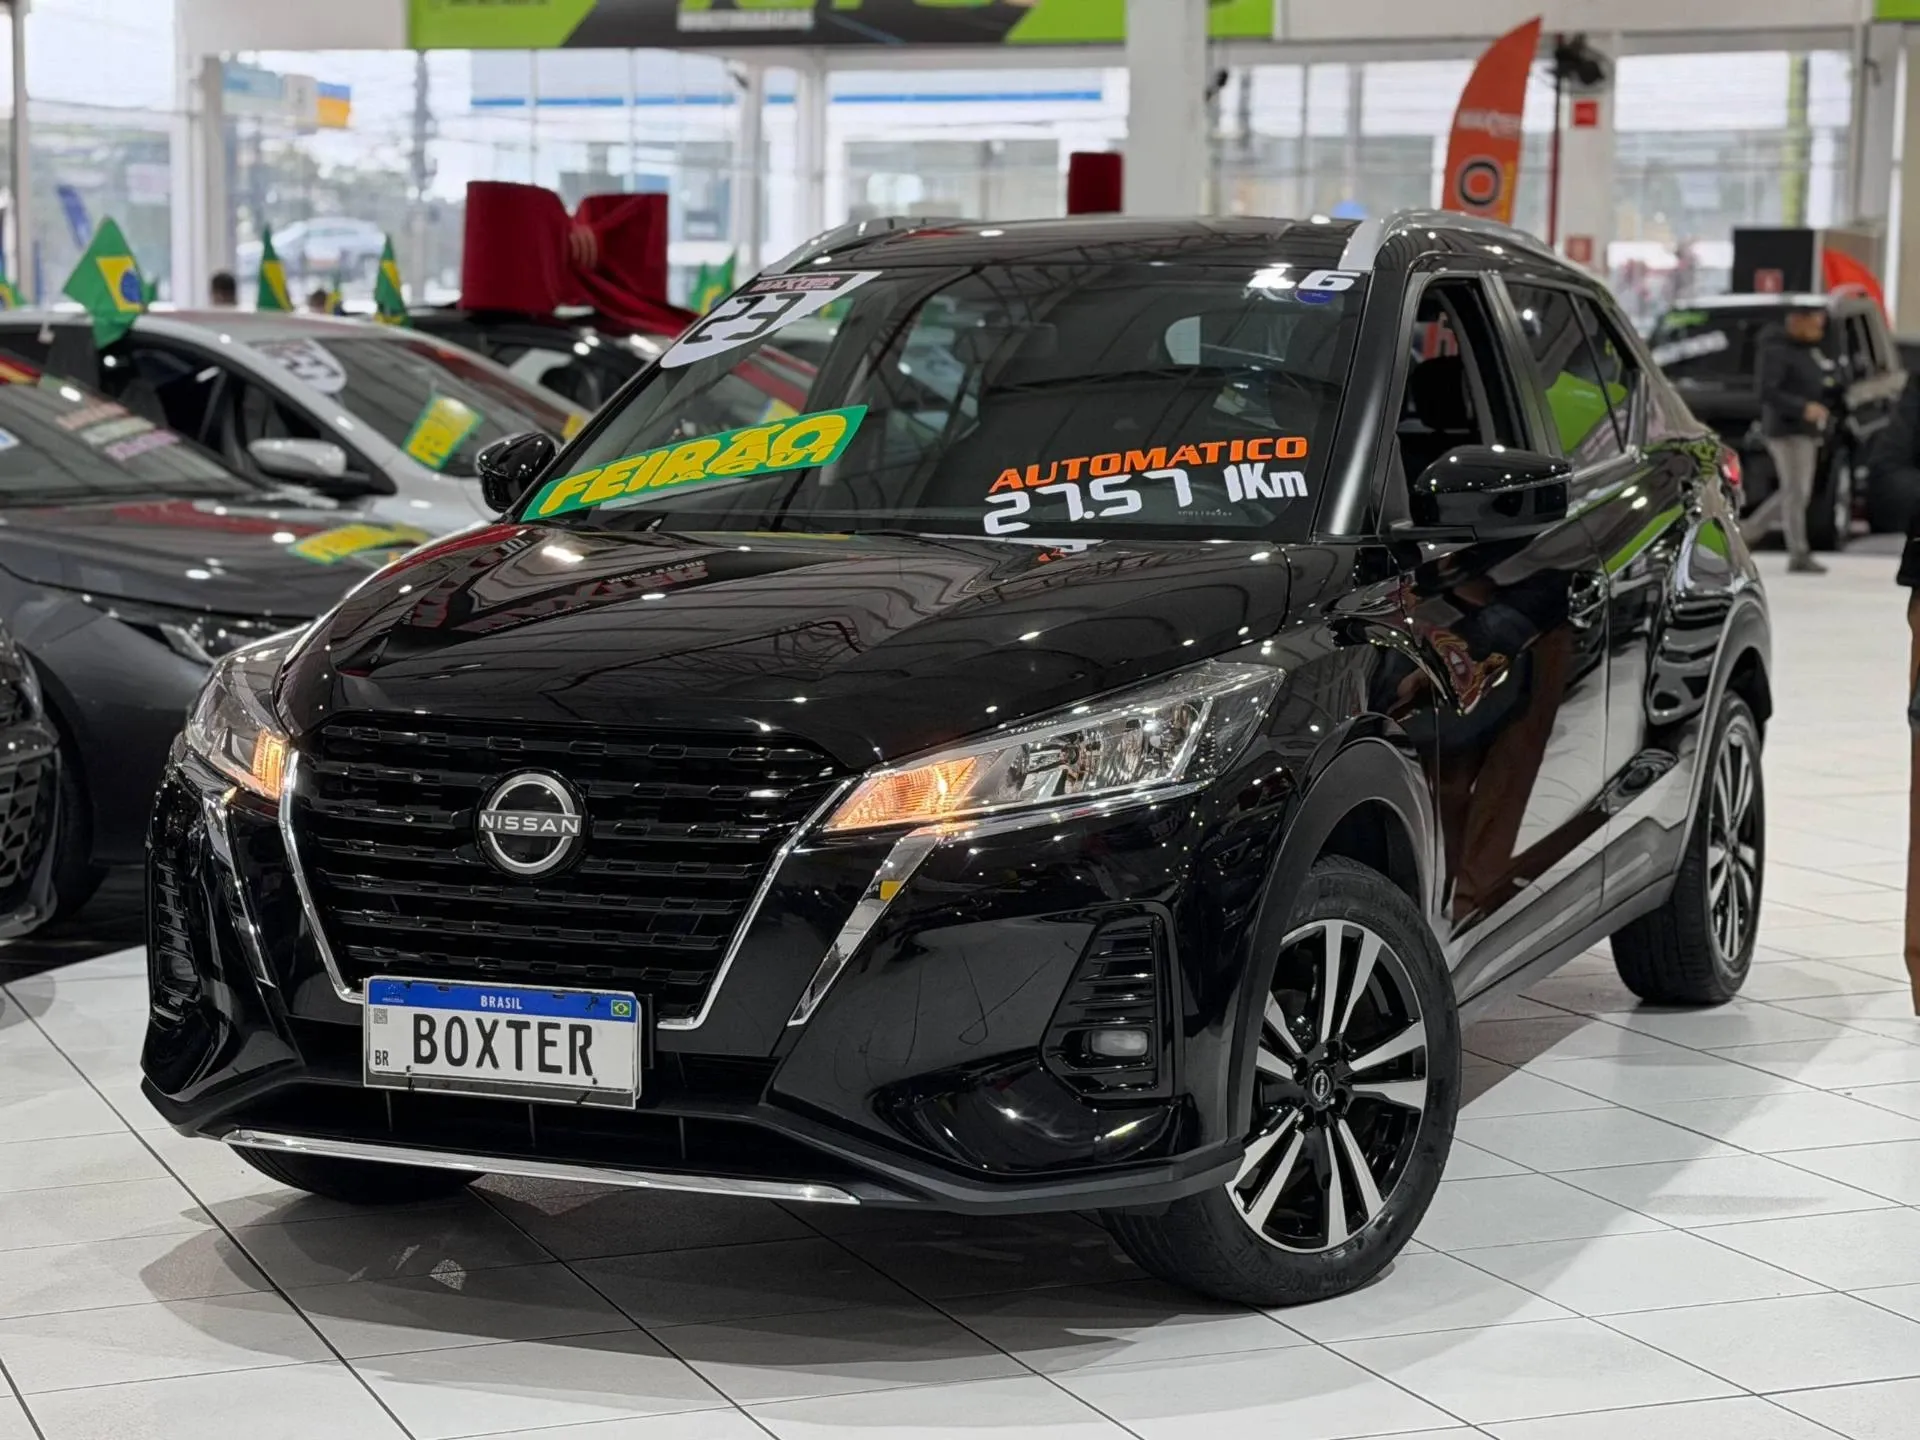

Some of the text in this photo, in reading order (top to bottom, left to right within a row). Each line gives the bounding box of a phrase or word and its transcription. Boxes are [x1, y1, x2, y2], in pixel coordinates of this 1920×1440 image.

[683, 292, 807, 345] 23
[988, 436, 1308, 493] AUTOMATICO
[480, 814, 579, 834] NISSAN
[480, 995, 523, 1010] BRASIL
[375, 1049, 390, 1067] BR
[412, 1013, 594, 1077] BOXTER
